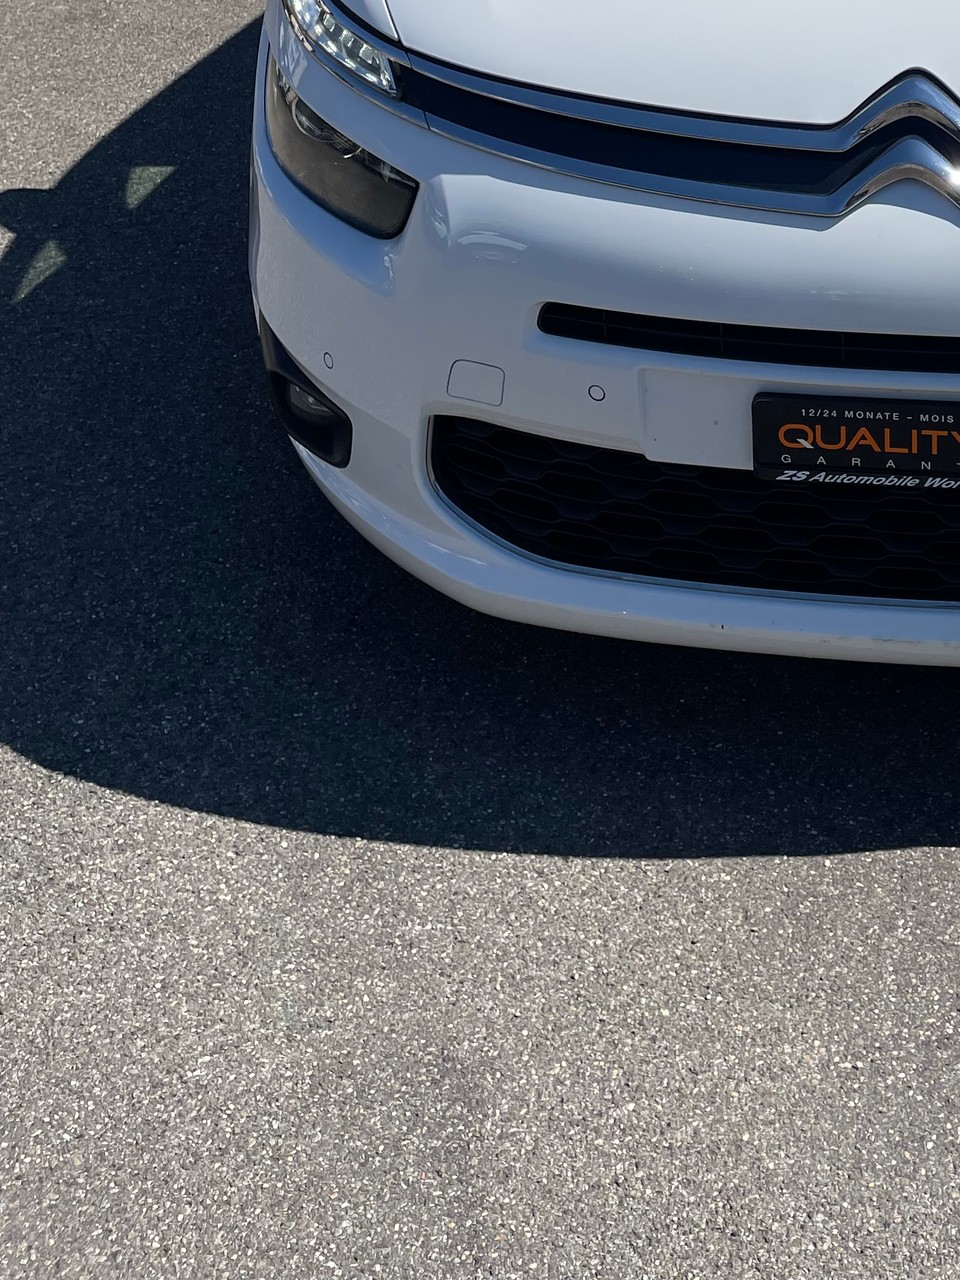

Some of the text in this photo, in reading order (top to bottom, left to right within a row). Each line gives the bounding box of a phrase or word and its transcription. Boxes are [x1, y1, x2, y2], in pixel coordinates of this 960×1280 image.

[801, 408, 838, 418] 12/24
[845, 410, 900, 421] MONATE
[919, 414, 954, 424] MOIS
[776, 470, 810, 482] ZS
[808, 471, 921, 487] Automobile
